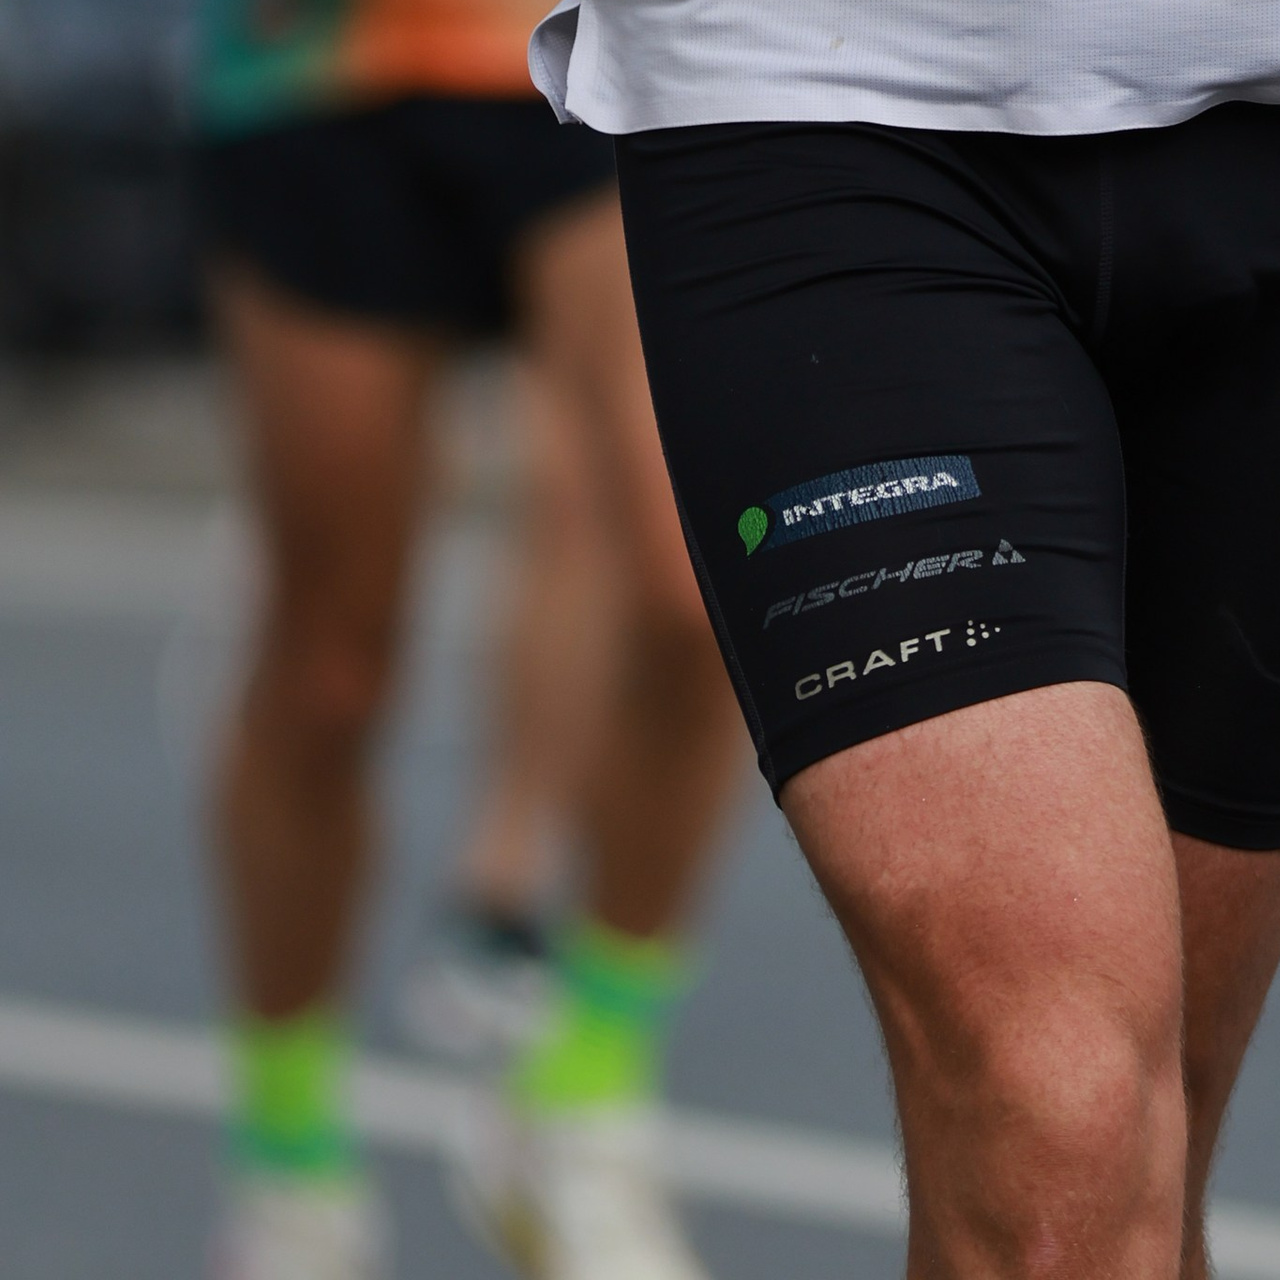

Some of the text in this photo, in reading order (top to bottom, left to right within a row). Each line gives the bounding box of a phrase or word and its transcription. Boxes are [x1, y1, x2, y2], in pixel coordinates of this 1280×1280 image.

[783, 472, 958, 527] INTEGRA
[762, 549, 984, 630] FISCHER
[794, 628, 951, 701] CRAFT
